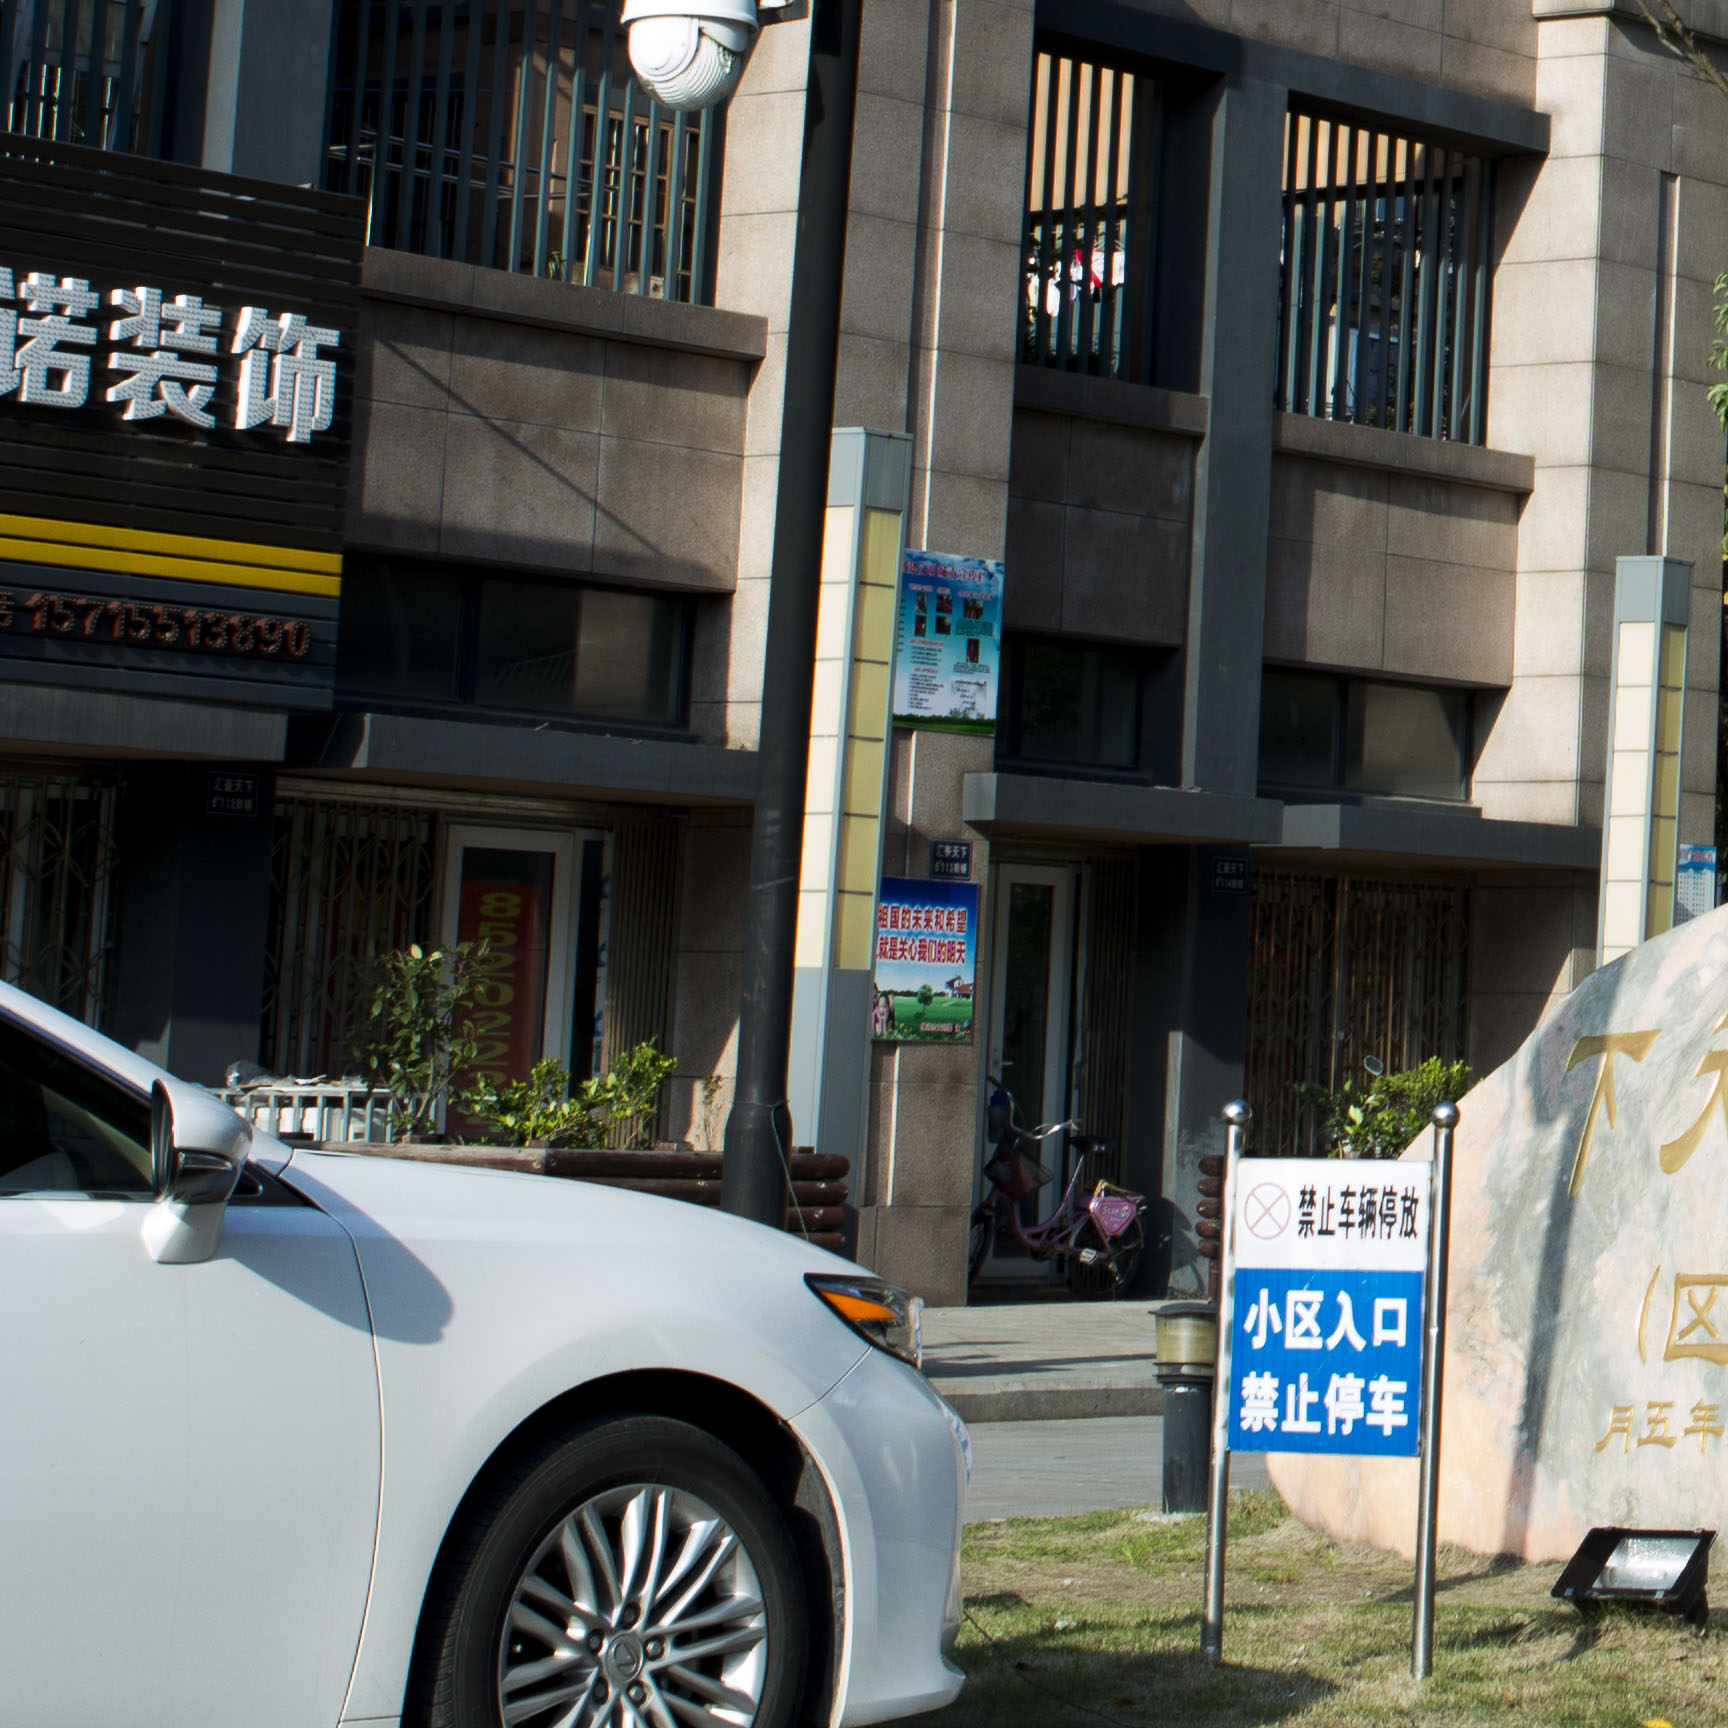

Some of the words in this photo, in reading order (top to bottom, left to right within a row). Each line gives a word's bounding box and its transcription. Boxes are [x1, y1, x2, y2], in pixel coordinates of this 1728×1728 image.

[0, 266, 340, 443] 诺装饰
[878, 905, 967, 934] 祖国的未来和希望
[1297, 1183, 1420, 1240] 禁止车辆停放
[1243, 1288, 1409, 1353] 小区入口
[1240, 1371, 1409, 1436] 禁止停车
